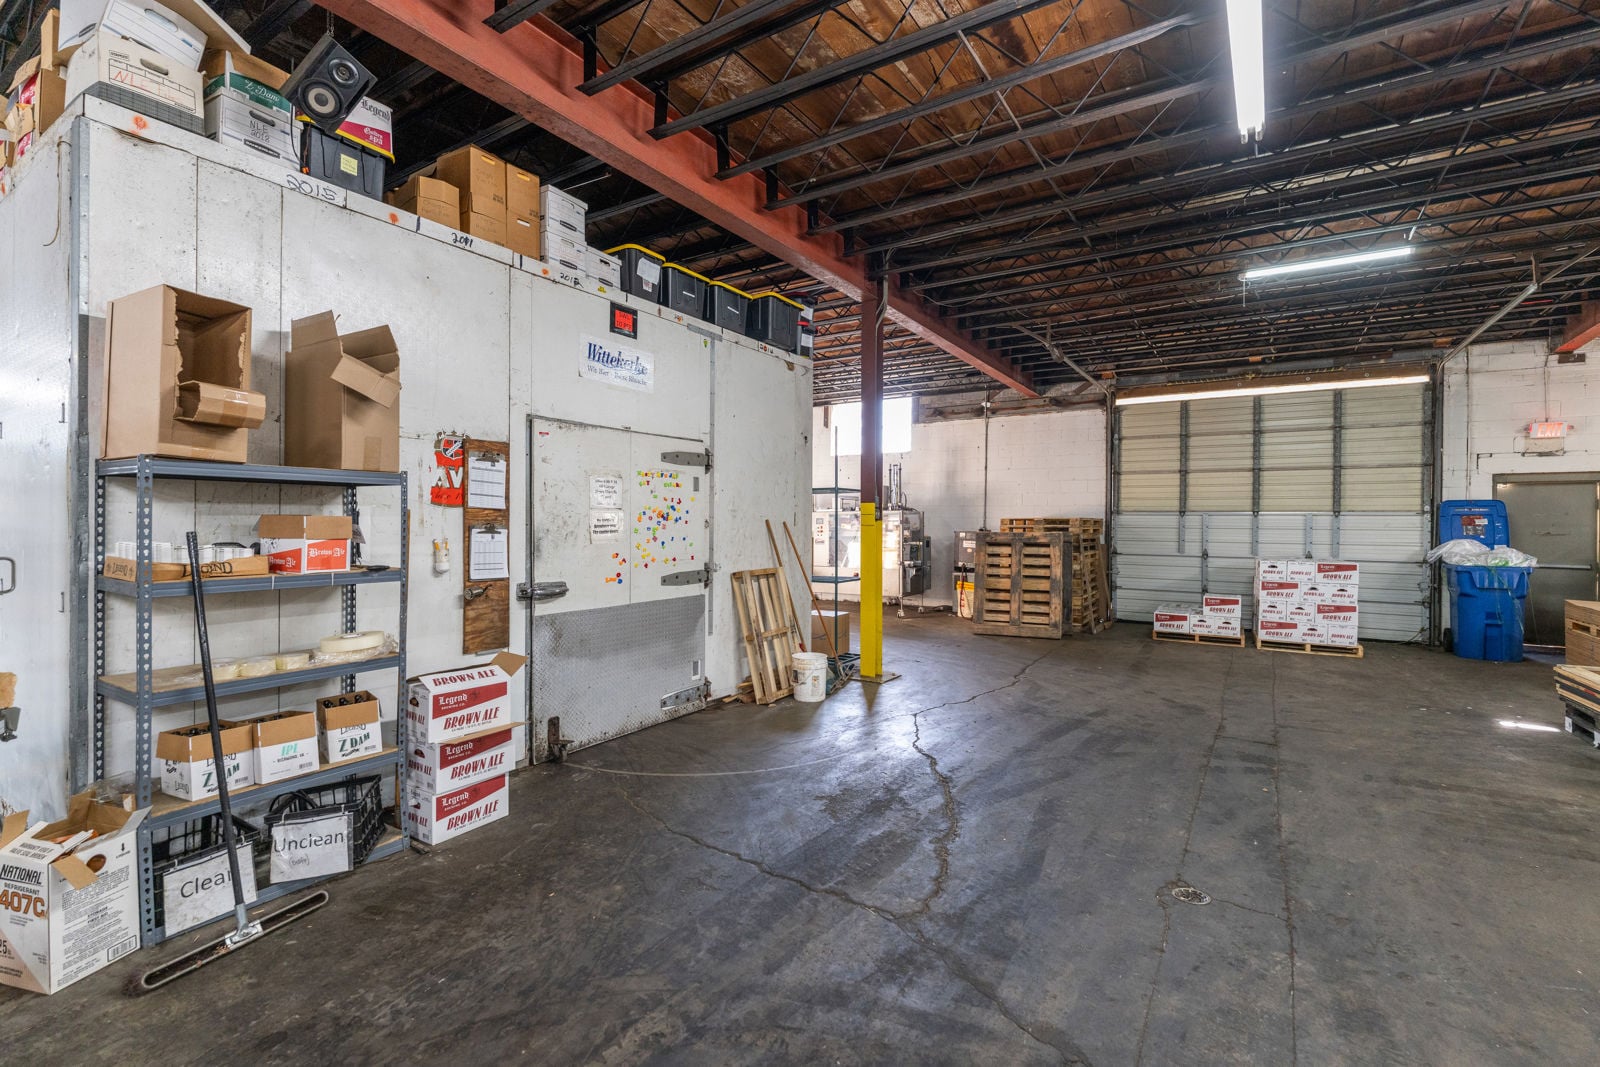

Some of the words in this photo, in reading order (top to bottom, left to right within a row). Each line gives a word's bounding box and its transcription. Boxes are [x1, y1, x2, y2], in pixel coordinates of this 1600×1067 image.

[249, 120, 268, 132] NLE
[286, 174, 337, 201] 2015
[1537, 422, 1562, 437] EXIT
[182, 561, 233, 578] LGEND
[433, 673, 474, 687] BROWN
[478, 669, 498, 679] ALE
[438, 693, 468, 705] Legend
[443, 710, 481, 730] BROWN
[482, 706, 500, 721] ALE
[338, 739, 348, 753] Z
[350, 731, 370, 749] DAM
[445, 741, 474, 755] Legend
[450, 758, 487, 780] BROWN
[487, 752, 505, 767] ALE
[202, 771, 214, 788] Z
[442, 791, 469, 806] Legend
[447, 806, 482, 831] BROWN
[482, 799, 499, 815] ALE
[274, 831, 344, 853] Unclean
[0, 863, 42, 885] NATIONAL
[4, 882, 40, 896] REFRIGERANT
[0, 889, 45, 918] 407C
